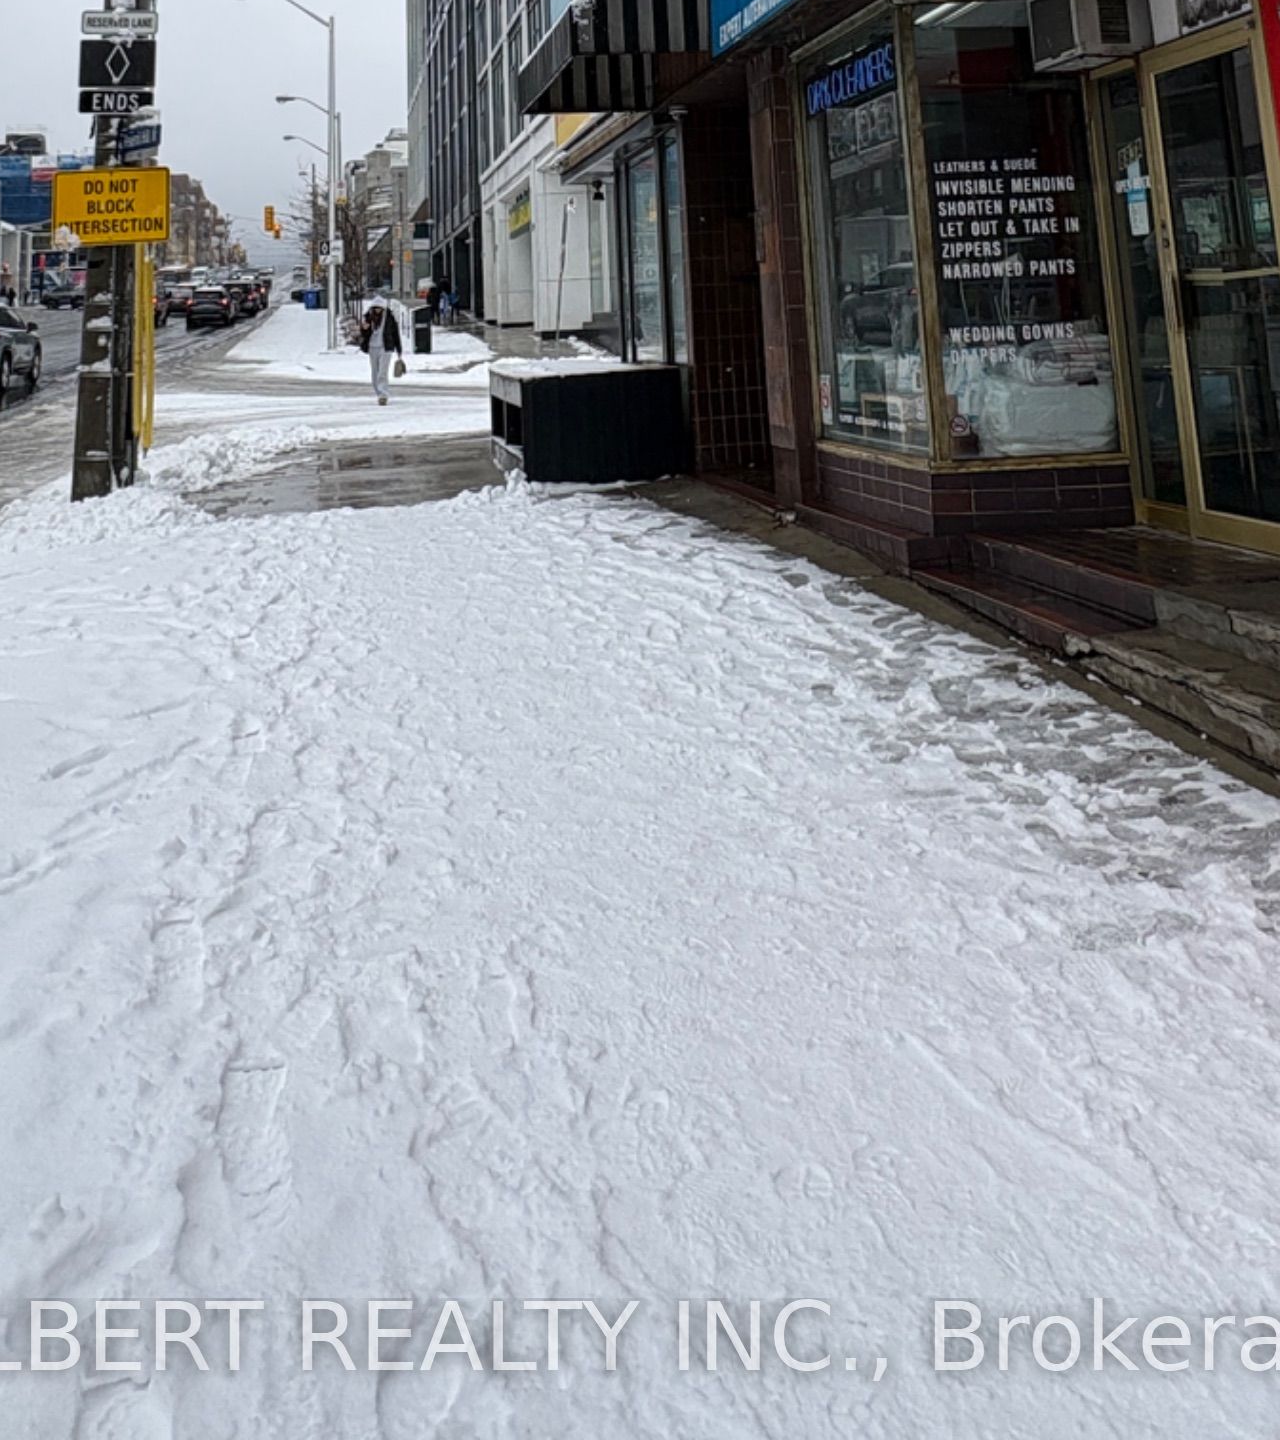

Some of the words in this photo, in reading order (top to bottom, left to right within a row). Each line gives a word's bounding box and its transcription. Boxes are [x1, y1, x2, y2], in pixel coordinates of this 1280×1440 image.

[131, 16, 153, 29] LANE
[92, 93, 140, 110] ENDS
[934, 161, 985, 174] LEATHERS
[83, 180, 103, 195] DO
[109, 178, 138, 194] NOT
[935, 178, 1004, 196] INVISIBLE
[1011, 175, 1075, 193] MENDING
[86, 199, 135, 215] BLOCK
[938, 199, 1002, 216] SHORTEN
[1009, 197, 1054, 214] PANTS
[58, 217, 164, 235] TERSECTION
[939, 221, 963, 238] LET
[971, 220, 998, 236] OUT
[1005, 219, 1016, 235] &
[1023, 217, 1059, 234] TAKE
[1065, 216, 1080, 233] IN
[942, 241, 1002, 258] ZIPPERS
[943, 262, 1023, 279] NARROWED
[1030, 259, 1075, 276] PANTS
[949, 325, 1016, 343] WEDDING
[1022, 322, 1074, 340] GOWNS
